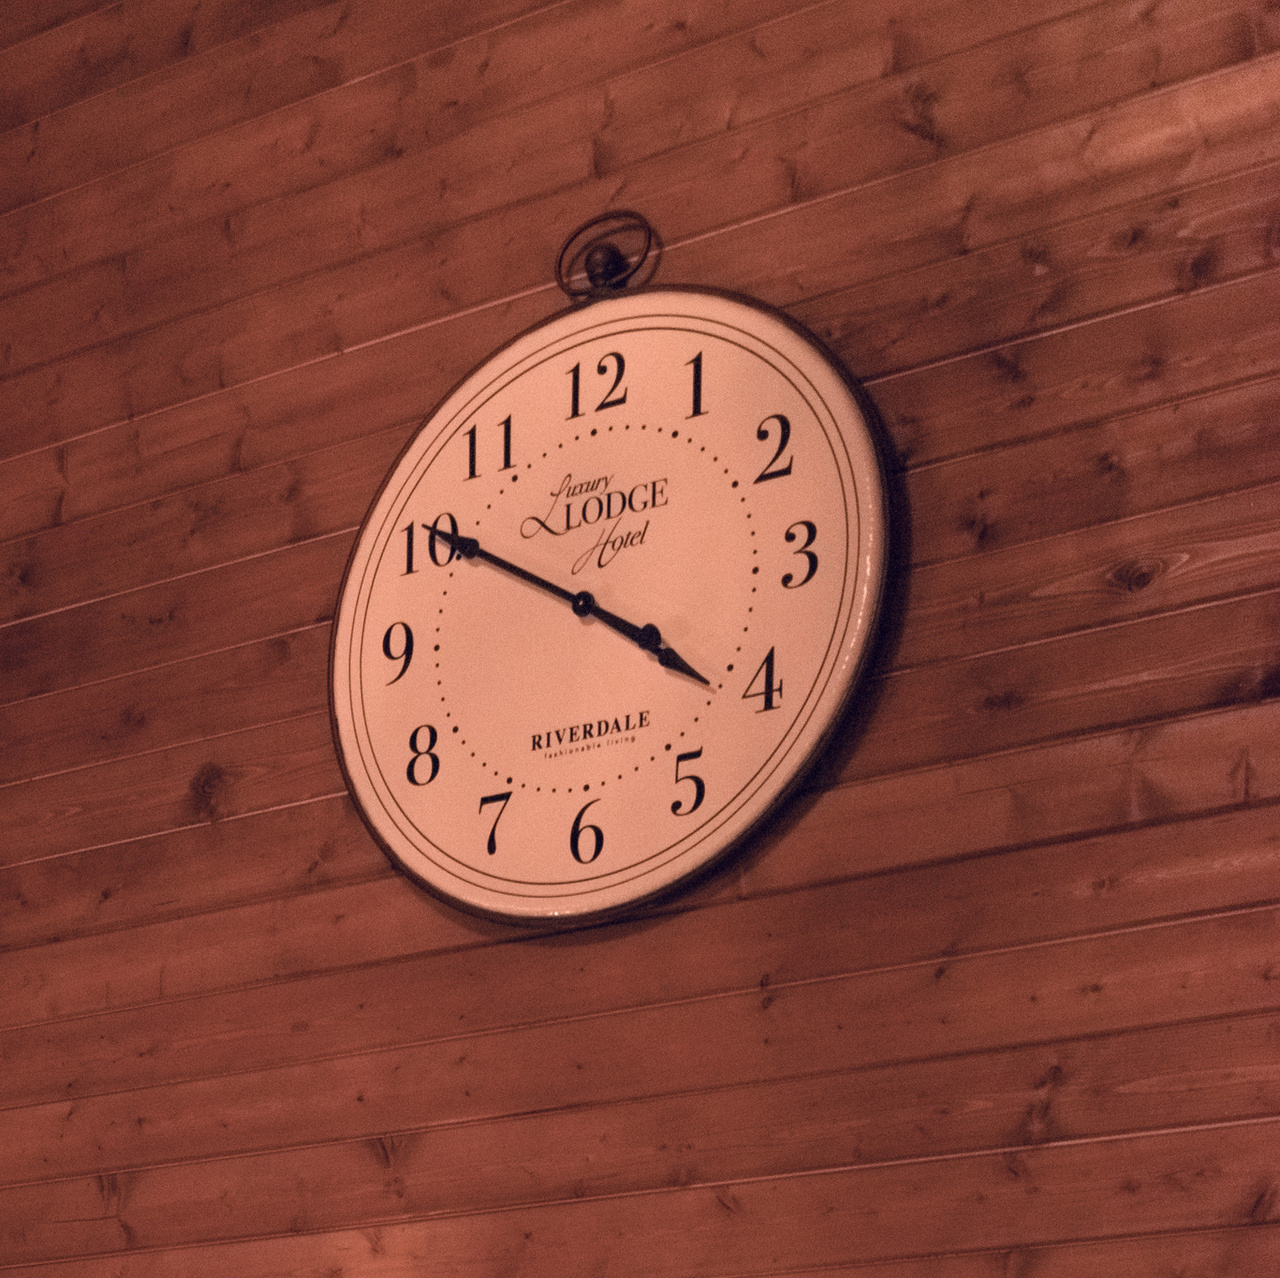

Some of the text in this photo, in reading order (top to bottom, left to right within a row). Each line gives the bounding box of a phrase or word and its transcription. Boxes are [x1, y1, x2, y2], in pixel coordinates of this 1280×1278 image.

[564, 351, 629, 421] 12
[684, 351, 709, 420] 1
[461, 413, 519, 482] 11
[753, 413, 794, 485] 2
[564, 478, 669, 531] LODGE
[400, 512, 459, 577] 10
[571, 517, 650, 575] Hotel
[781, 520, 818, 589] 3
[382, 621, 414, 686] 9
[741, 645, 783, 714] 4
[406, 724, 441, 787] 8
[531, 710, 651, 751] RIVERDALE
[544, 736, 636, 759] fashionable living
[670, 746, 706, 817] 5
[478, 791, 513, 856] 7
[569, 798, 604, 865] 6
